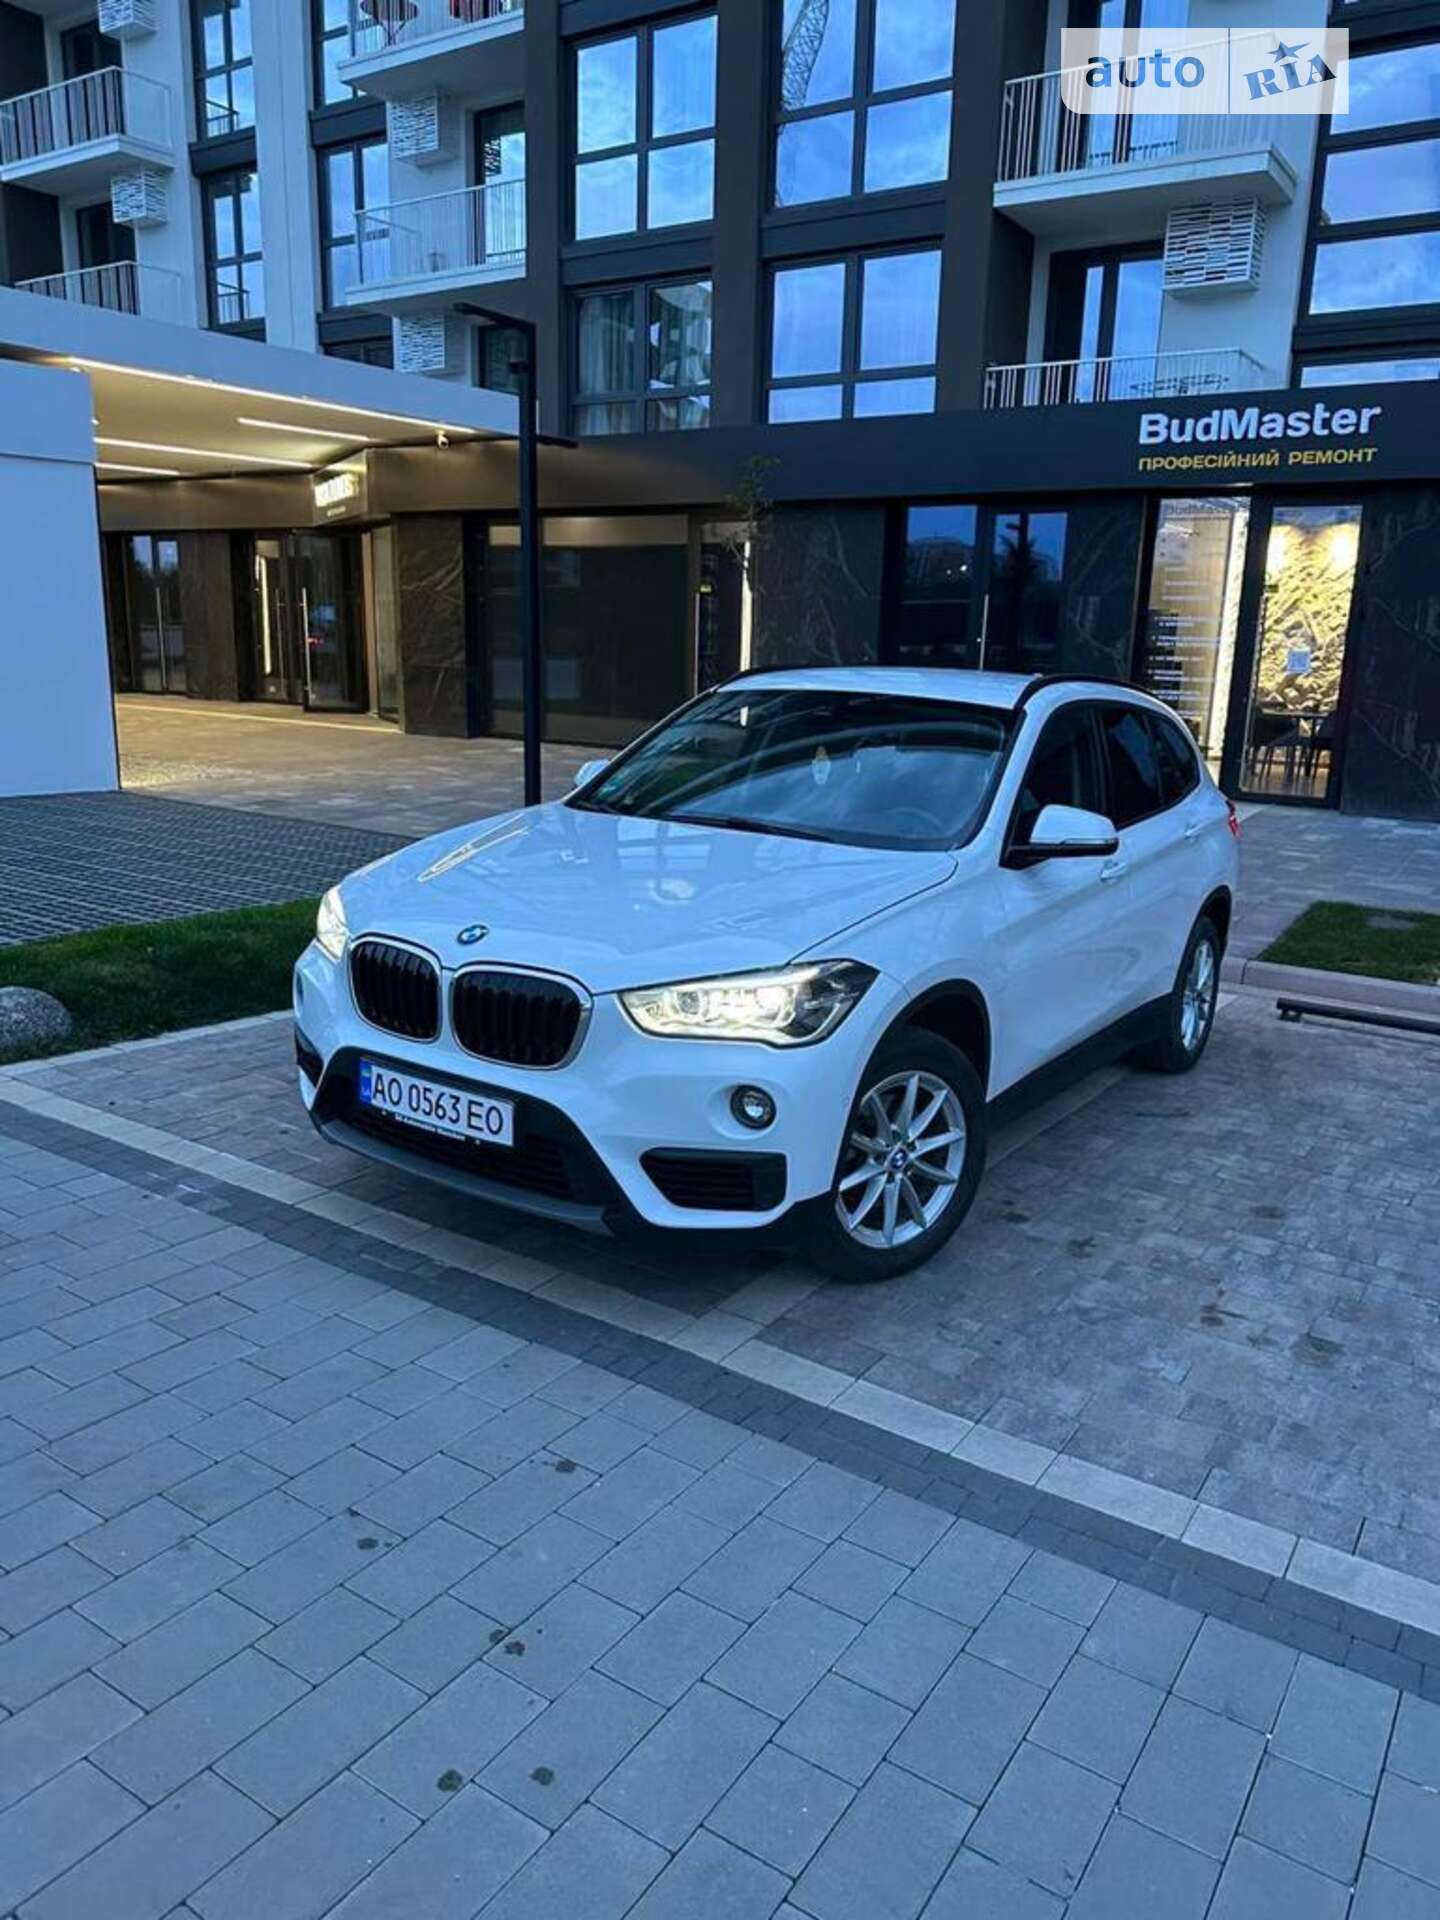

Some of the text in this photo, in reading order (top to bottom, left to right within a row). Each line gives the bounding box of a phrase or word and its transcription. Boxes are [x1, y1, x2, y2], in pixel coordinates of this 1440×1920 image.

[1138, 402, 1382, 445] BudMaster
[1138, 448, 1378, 472] ПРОФЕСІЙНИЙ РЕМОНТ
[372, 1072, 403, 1106] AO
[408, 1083, 461, 1124] 0563
[466, 1100, 504, 1136] EO
